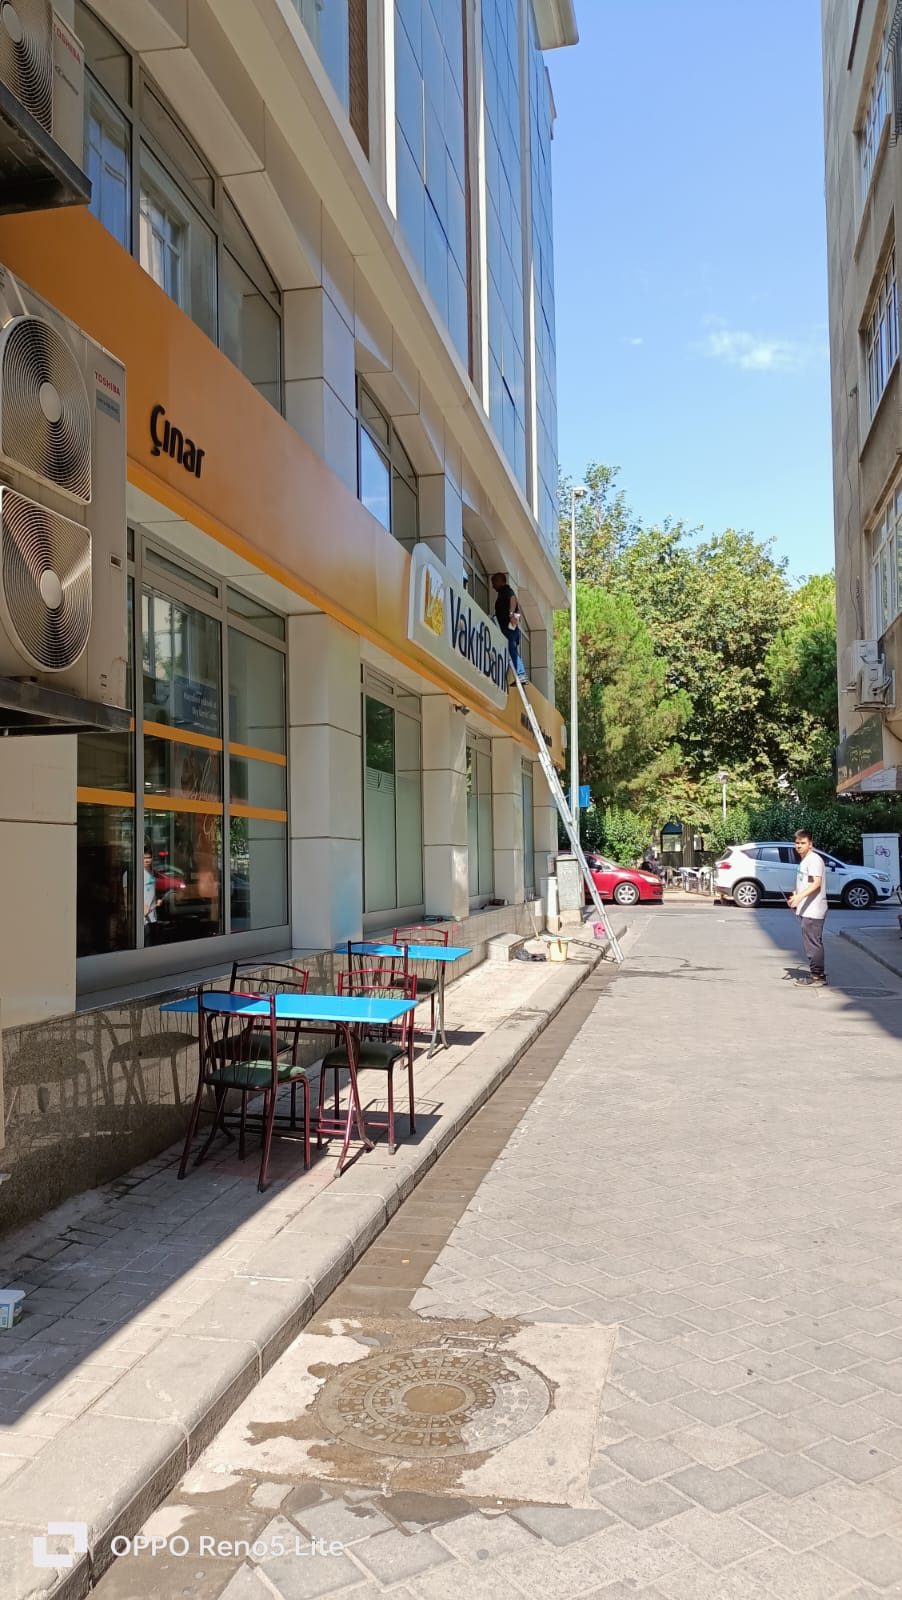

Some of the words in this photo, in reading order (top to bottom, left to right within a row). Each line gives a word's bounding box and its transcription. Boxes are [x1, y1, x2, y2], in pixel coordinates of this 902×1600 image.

[53, 24, 80, 63] TOSHIBA
[94, 371, 120, 396] TOSHIBA
[150, 404, 205, 478] Çınar
[449, 587, 510, 694] VakıfBank
